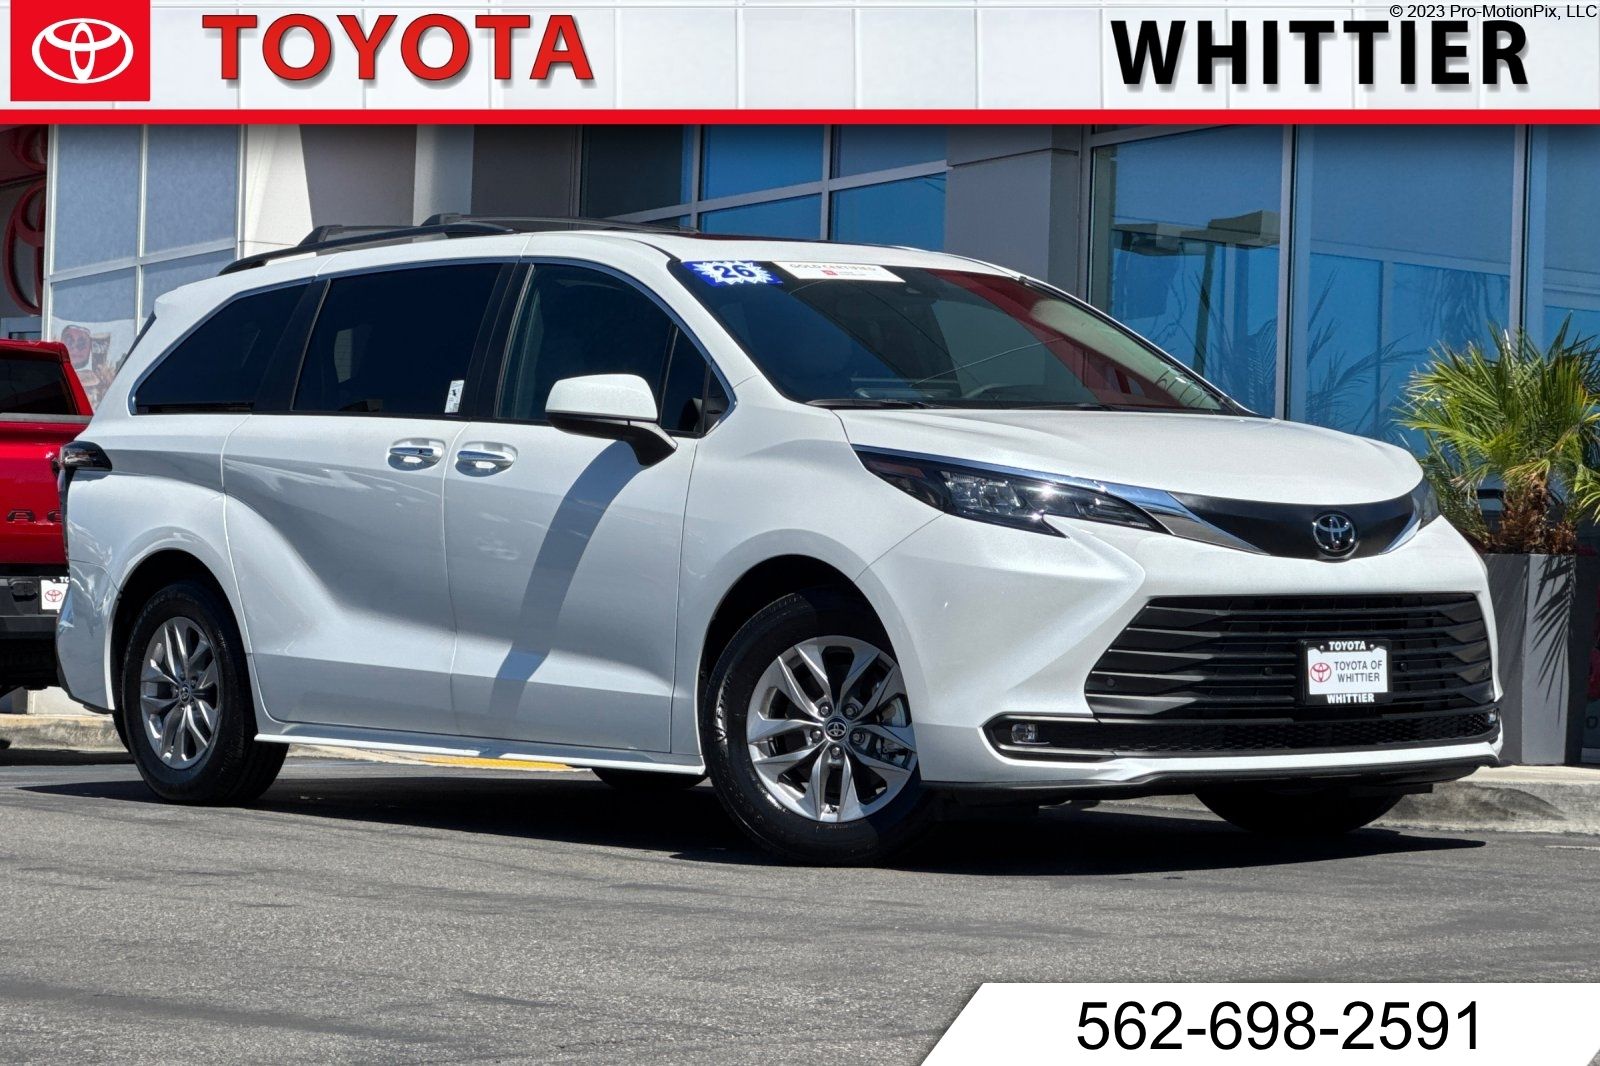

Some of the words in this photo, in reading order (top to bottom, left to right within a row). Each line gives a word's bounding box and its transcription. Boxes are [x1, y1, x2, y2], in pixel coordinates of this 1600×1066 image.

[712, 264, 757, 278] 26
[1328, 641, 1366, 651] TOYOTA
[1334, 661, 1368, 671] TOYOTA
[1370, 660, 1383, 670] OF
[1337, 672, 1380, 683] WHITTIER
[1327, 693, 1375, 704] WHITTIER
